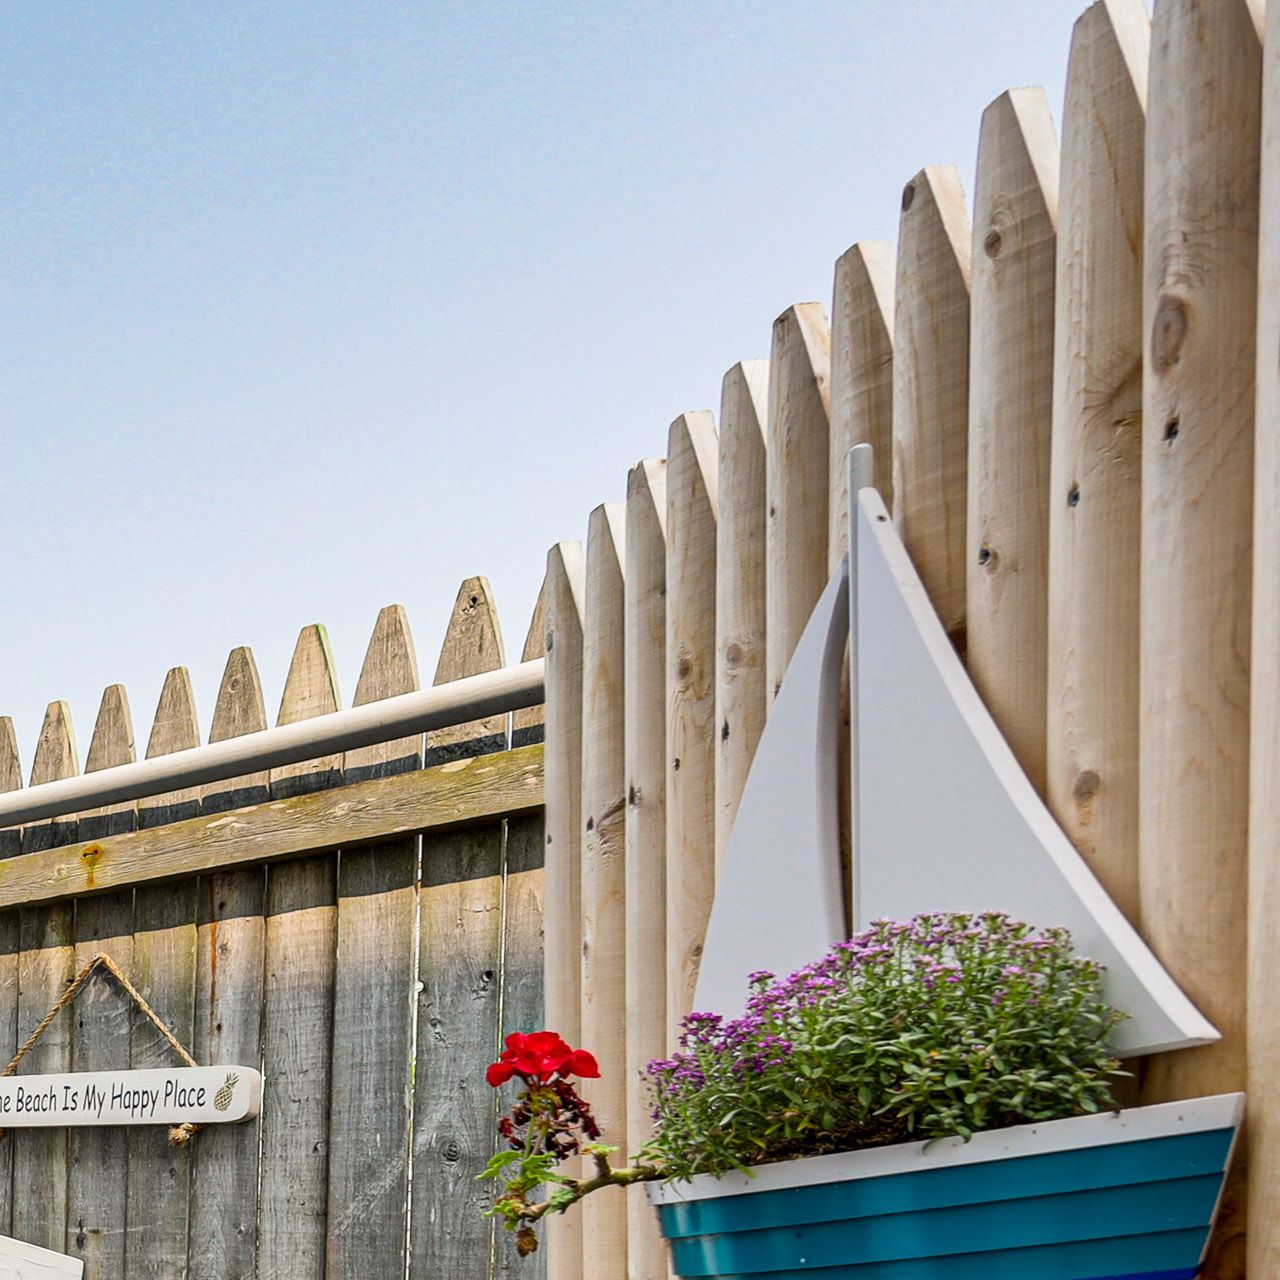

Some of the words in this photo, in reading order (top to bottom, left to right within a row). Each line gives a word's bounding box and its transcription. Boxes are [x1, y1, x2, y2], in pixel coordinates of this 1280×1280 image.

[15, 1085, 58, 1113] Beach
[62, 1085, 78, 1112] Is
[82, 1083, 106, 1119] My
[111, 1082, 159, 1118] Happy
[164, 1078, 207, 1109] Place
